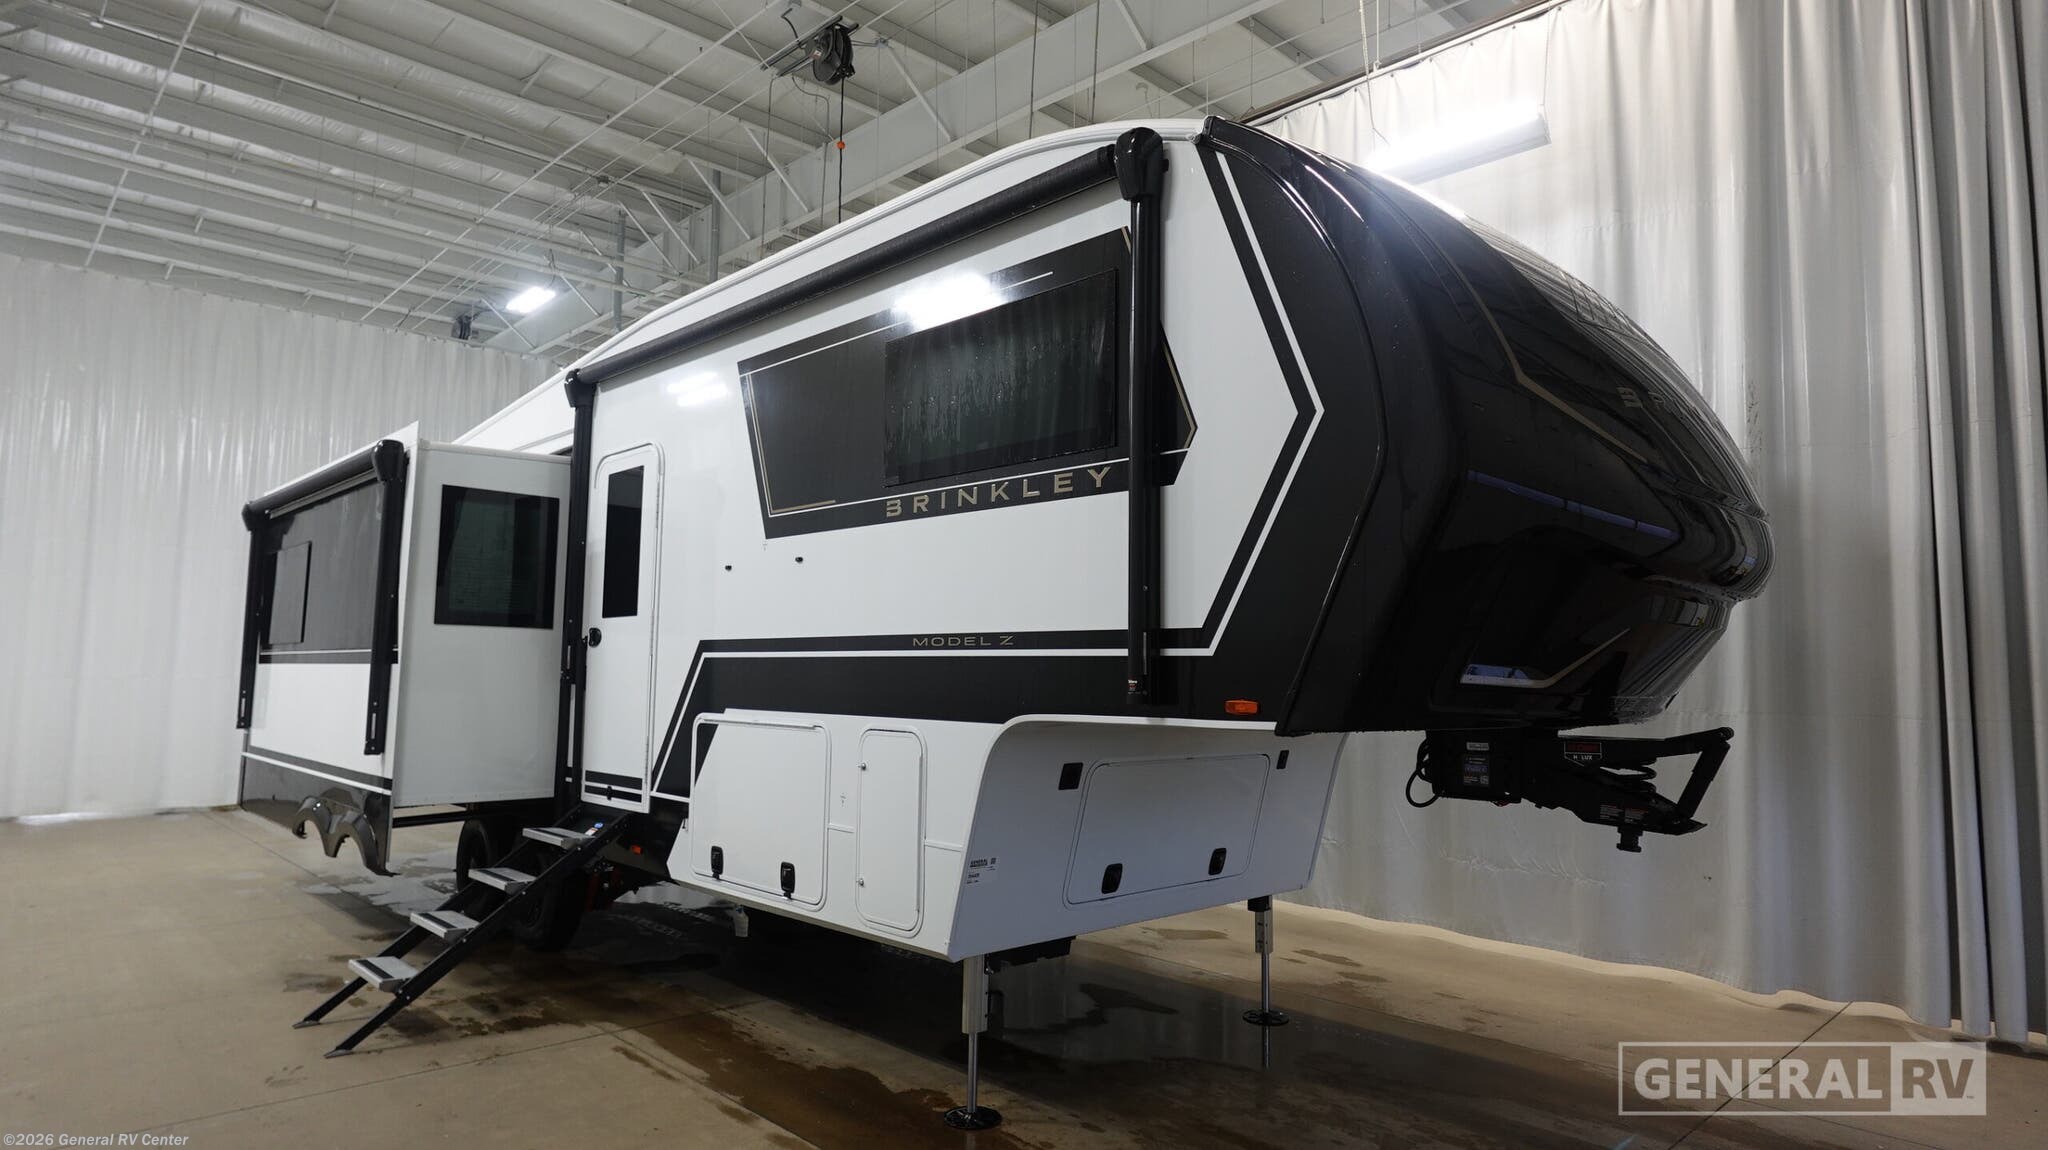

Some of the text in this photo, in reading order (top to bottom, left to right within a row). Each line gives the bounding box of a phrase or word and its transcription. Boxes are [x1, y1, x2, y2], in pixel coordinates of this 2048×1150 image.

[886, 466, 1111, 518] BRINKLEY
[913, 635, 1016, 647] MODEL Z
